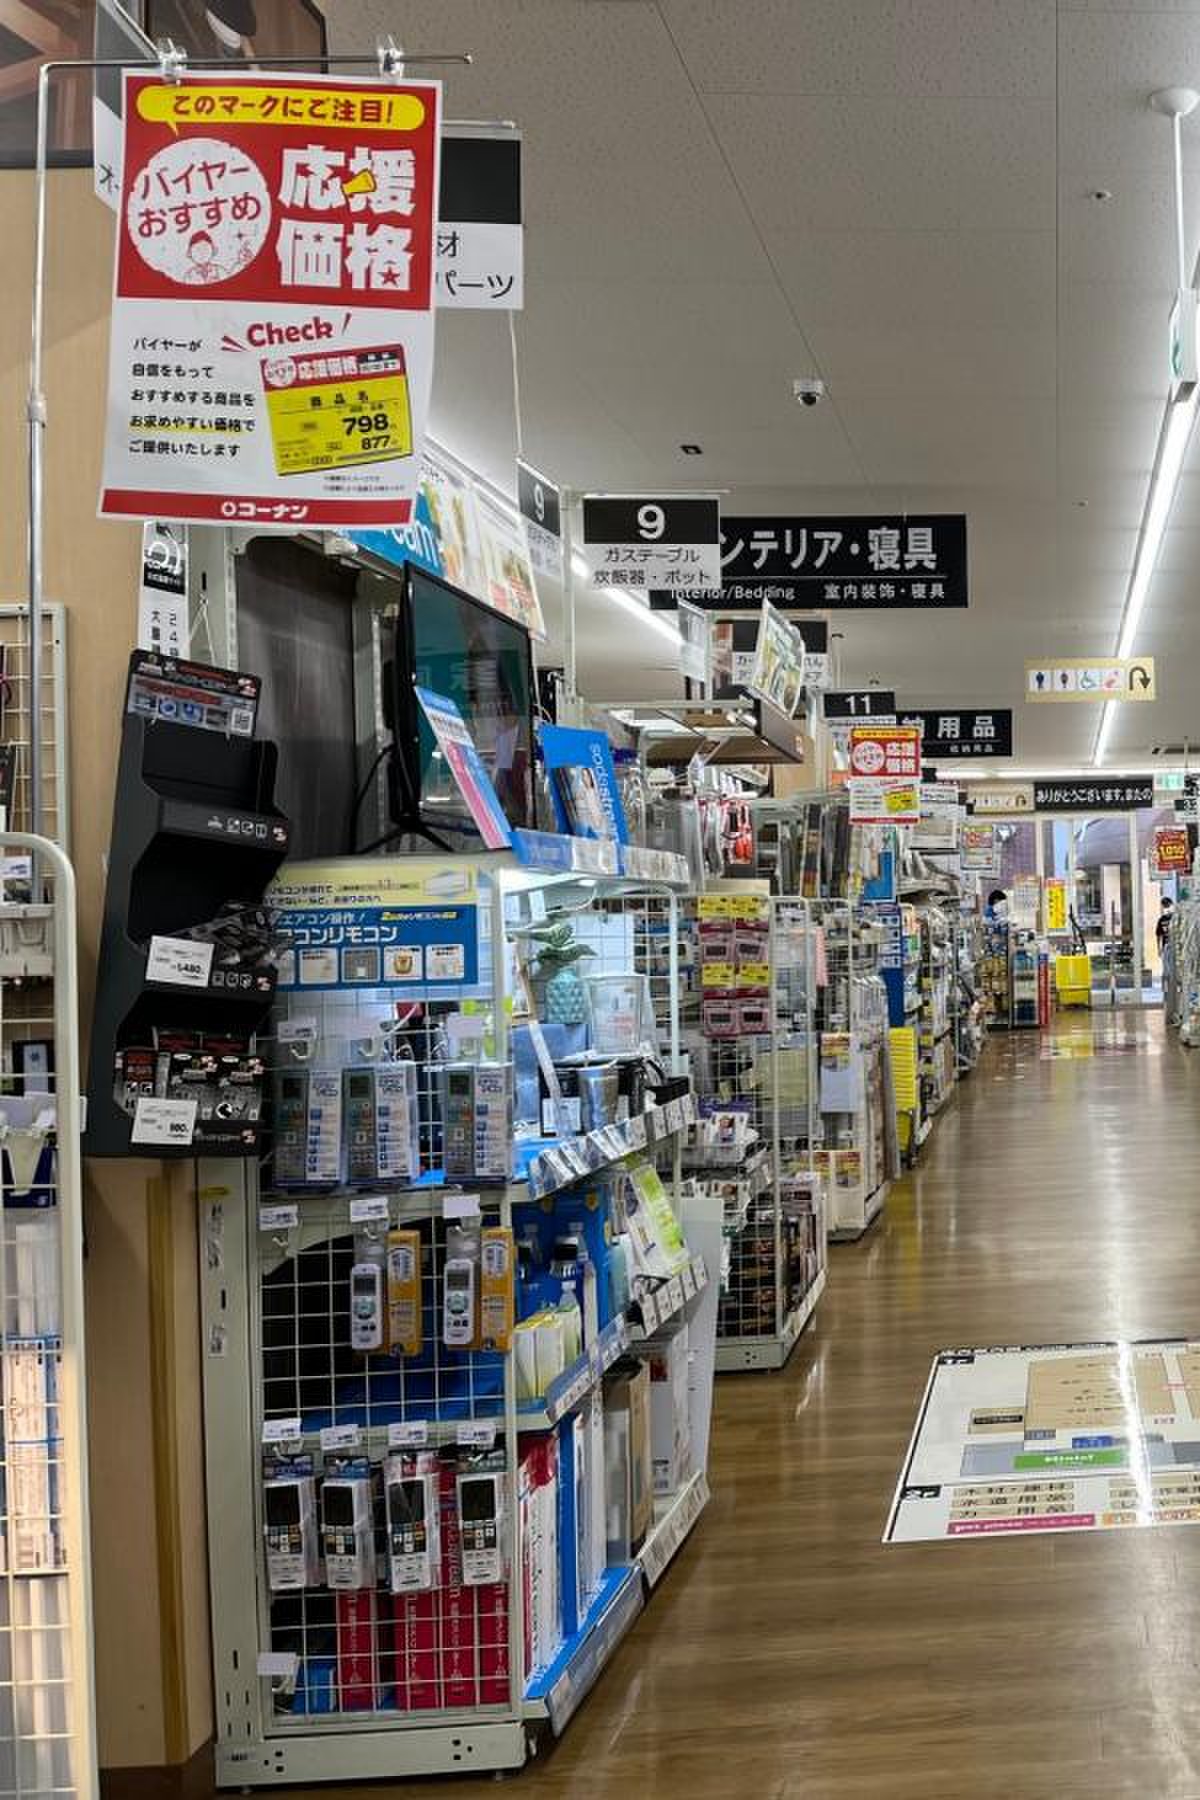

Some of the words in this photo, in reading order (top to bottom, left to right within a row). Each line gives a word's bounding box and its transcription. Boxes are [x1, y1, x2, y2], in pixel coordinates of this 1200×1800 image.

[172, 94, 394, 125] このマークにご注目!
[140, 160, 251, 201] バイヤー
[278, 145, 417, 216] 応援
[137, 193, 261, 239] おすすめ
[276, 219, 414, 292] 価格
[133, 337, 203, 353] バイヤーが
[246, 317, 334, 348] Check
[342, 414, 389, 435] 798
[361, 435, 391, 450] 877
[637, 505, 666, 539] 9
[845, 694, 871, 715] 11
